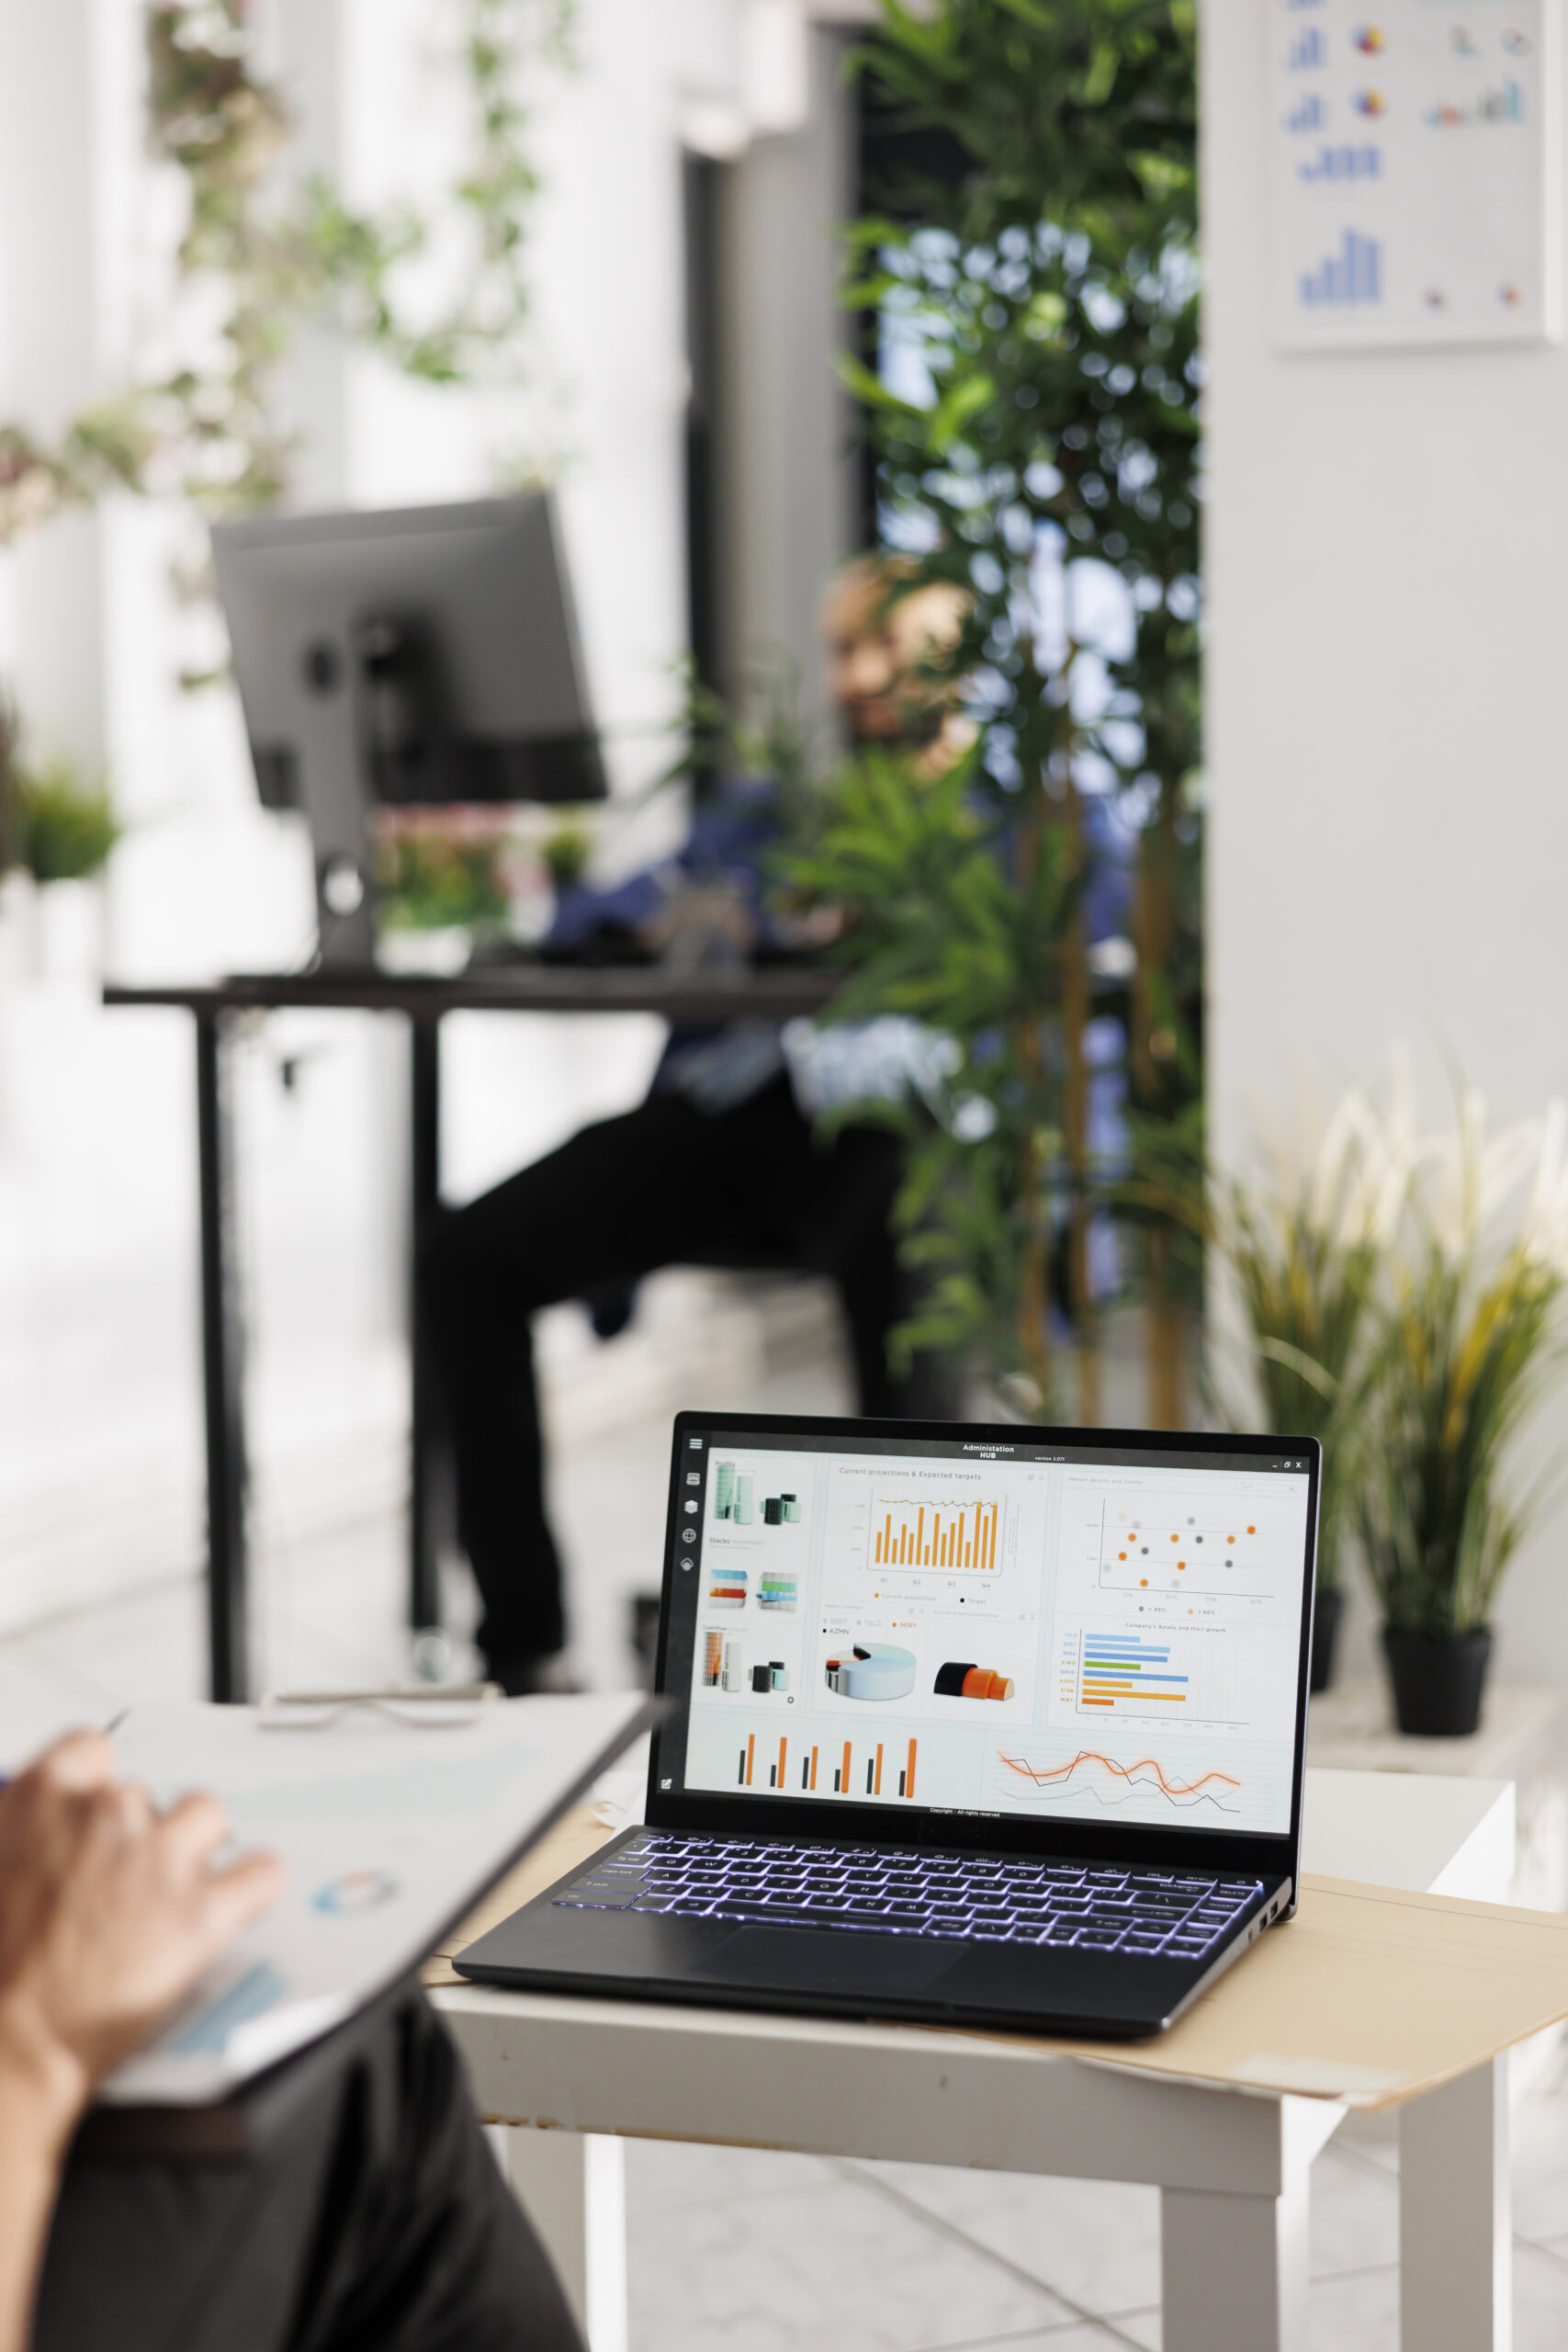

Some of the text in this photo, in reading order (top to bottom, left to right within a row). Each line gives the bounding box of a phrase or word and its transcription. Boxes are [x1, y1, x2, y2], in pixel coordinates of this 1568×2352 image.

[963, 1444, 1014, 1453] Administation
[869, 1469, 909, 1477] projections
[919, 1471, 953, 1479] Expected
